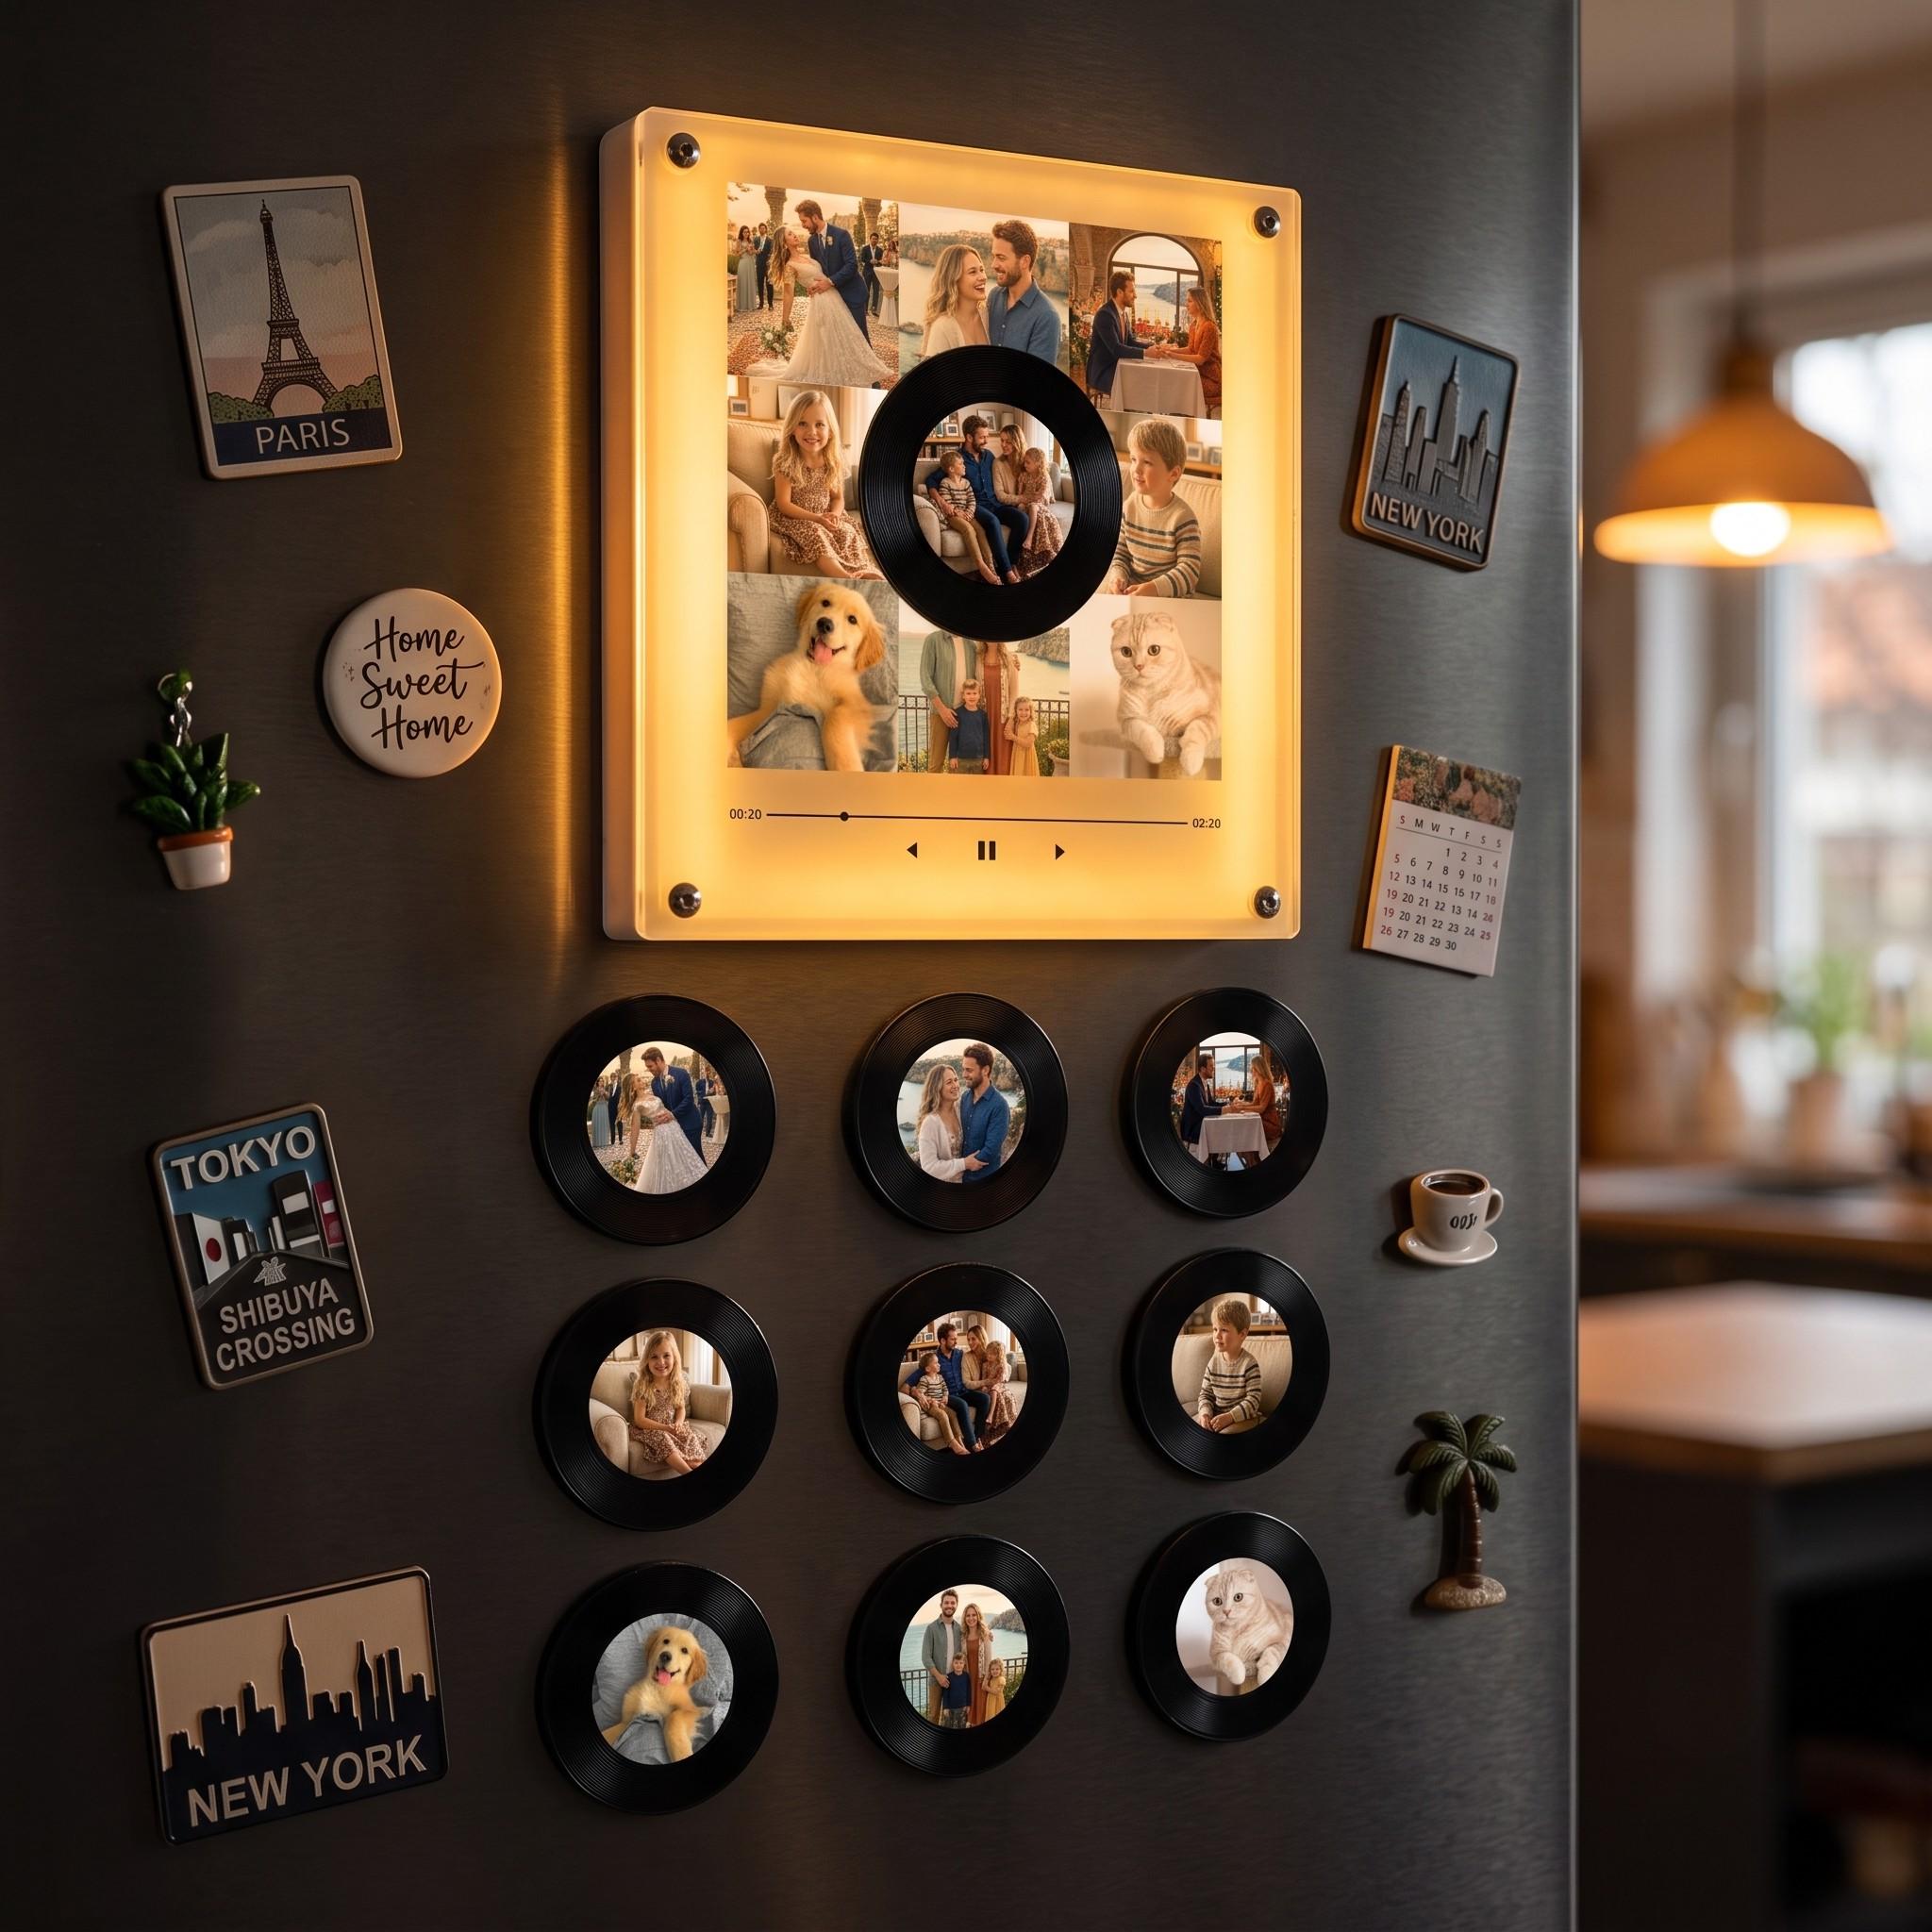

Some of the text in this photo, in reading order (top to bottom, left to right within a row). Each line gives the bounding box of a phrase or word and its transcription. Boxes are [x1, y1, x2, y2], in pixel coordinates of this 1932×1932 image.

[256, 418, 350, 455] PARIS
[1370, 491, 1485, 555] NEW YORK
[363, 615, 465, 662] Home
[360, 658, 485, 709] Sweet
[371, 705, 474, 750] Home
[729, 808, 762, 820] 00:20
[1192, 818, 1222, 829] 02:20
[1400, 815, 1501, 848] S M W T F S S
[1394, 854, 1497, 887] 5 6 7 8 9 10 11
[1446, 848, 1498, 869] 1 2 3 4
[1390, 871, 1400, 881] 12
[1407, 874, 1416, 885] 13
[1423, 879, 1432, 889] 14
[1439, 883, 1448, 893] 15
[1455, 887, 1465, 897] 16
[1471, 891, 1480, 901] 17
[1387, 889, 1398, 899] 19
[1402, 892, 1414, 904] 20
[1418, 896, 1428, 907] 21
[1435, 901, 1445, 911] 22
[1452, 905, 1461, 915] 13
[1468, 908, 1477, 919] 14
[1380, 924, 1457, 951] 26 27 28 29 30
[1383, 907, 1491, 941] 19 20 21 22 23 24 25
[170, 1125, 316, 1191] TOKYO
[219, 1277, 339, 1334] SHIBUYA
[216, 1307, 356, 1372] CROSSING
[188, 1734, 427, 1827] NEW YORK
